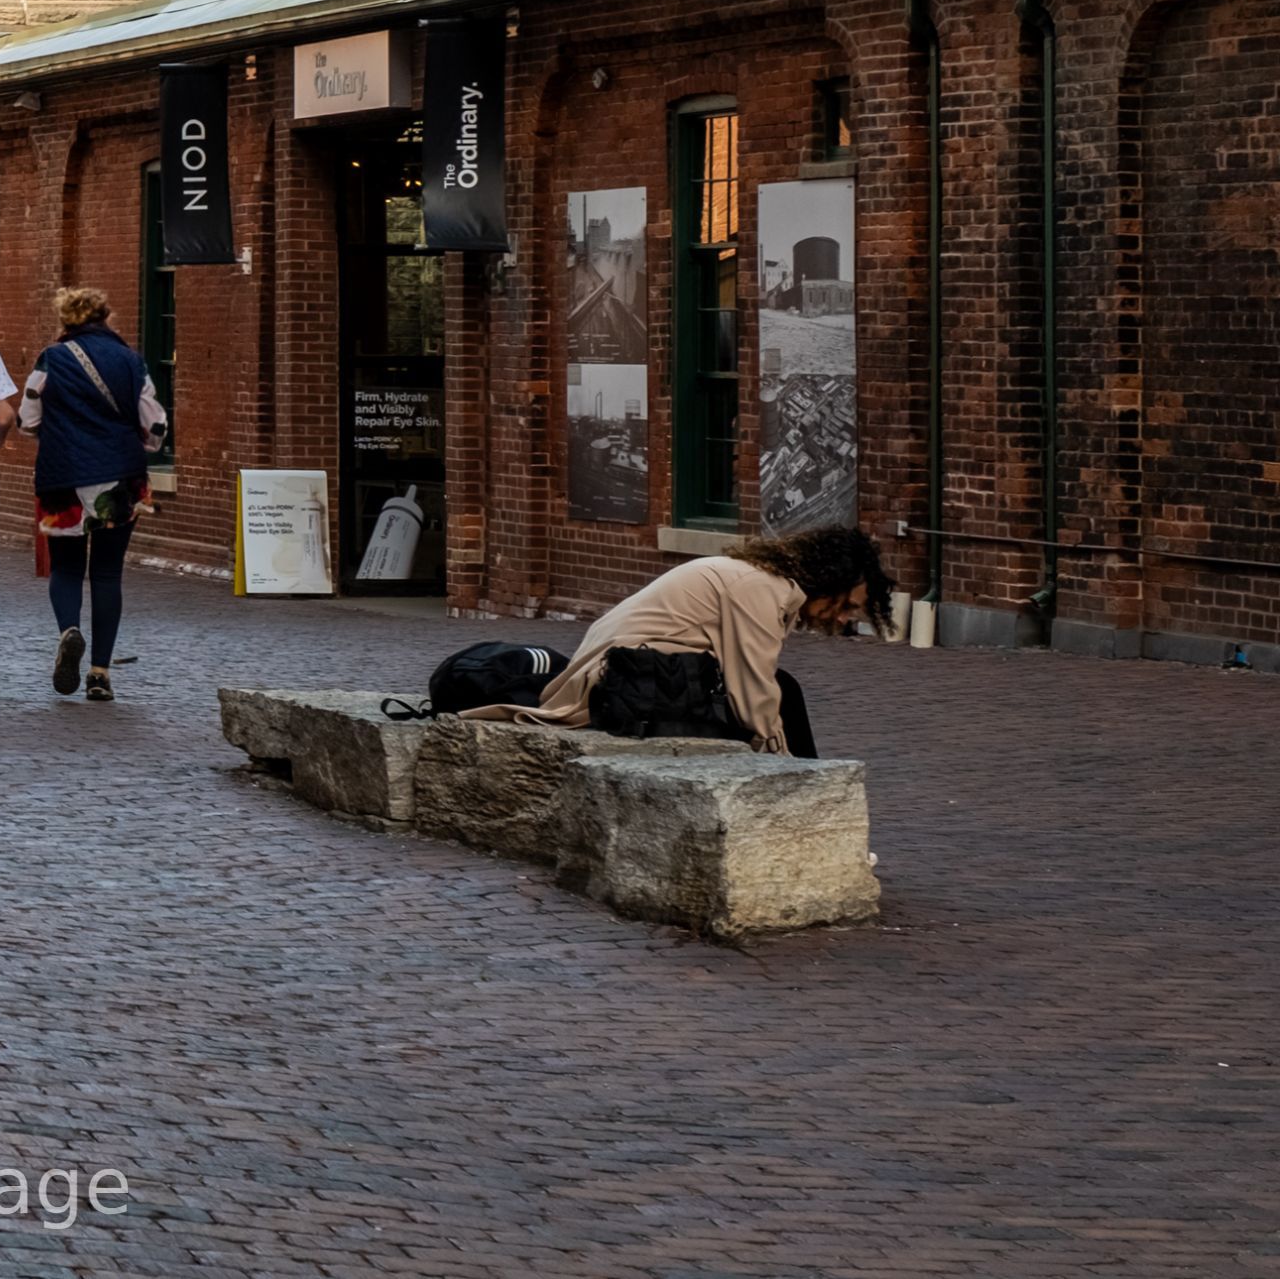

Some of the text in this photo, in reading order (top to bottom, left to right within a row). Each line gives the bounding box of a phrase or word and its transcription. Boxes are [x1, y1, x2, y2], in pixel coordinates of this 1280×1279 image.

[456, 82, 484, 189] Ordinary.
[182, 119, 208, 211] NIOD
[444, 164, 456, 189] The
[385, 392, 429, 404] Hydrate
[355, 404, 415, 416] and Visibly
[355, 417, 390, 428] Repair
[393, 417, 413, 429] Eye
